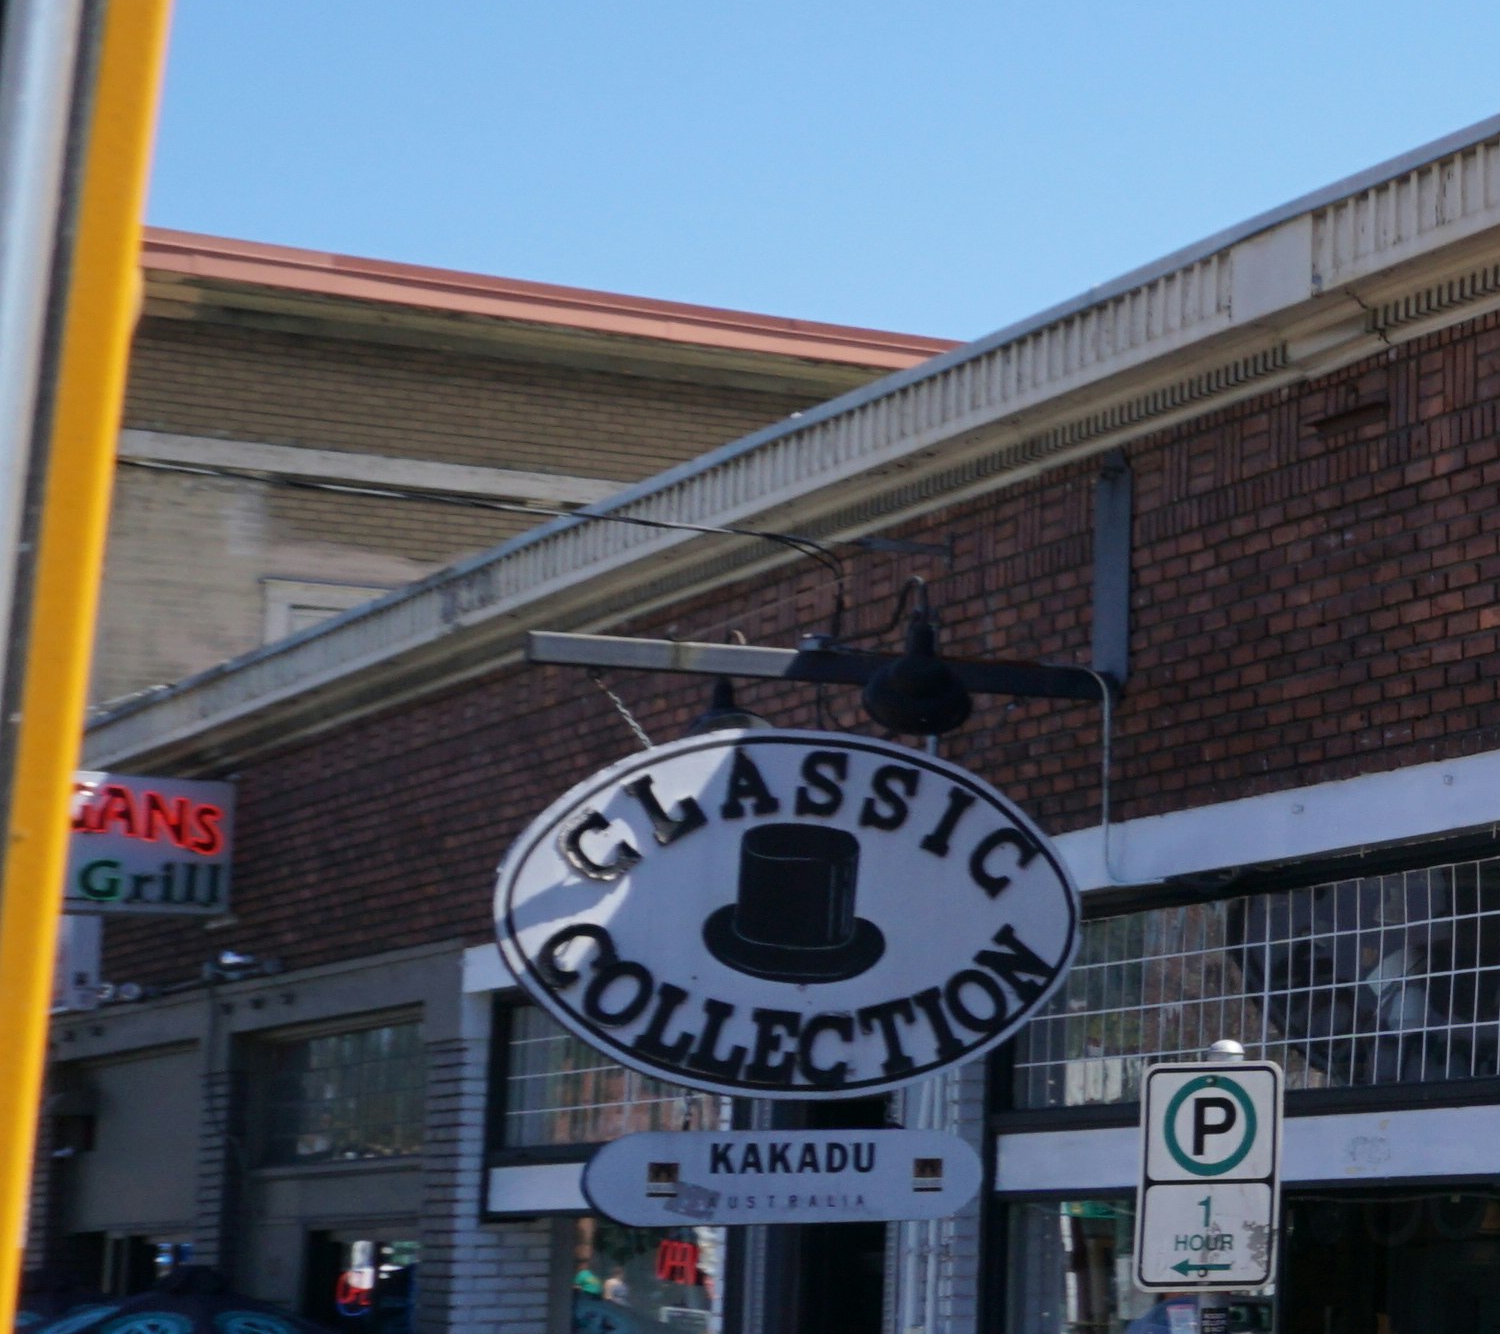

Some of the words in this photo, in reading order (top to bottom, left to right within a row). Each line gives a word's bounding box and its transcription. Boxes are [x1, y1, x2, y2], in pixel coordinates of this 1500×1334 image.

[557, 745, 1042, 899] CLASSIC
[78, 859, 222, 907] Grill
[536, 922, 1062, 1087] COLLECTION
[1193, 1097, 1237, 1156] P
[709, 1142, 876, 1174] KAKADU
[707, 1194, 867, 1209] AUSTRALIA
[1197, 1195, 1212, 1227] 1
[1174, 1233, 1235, 1252] HOUR
